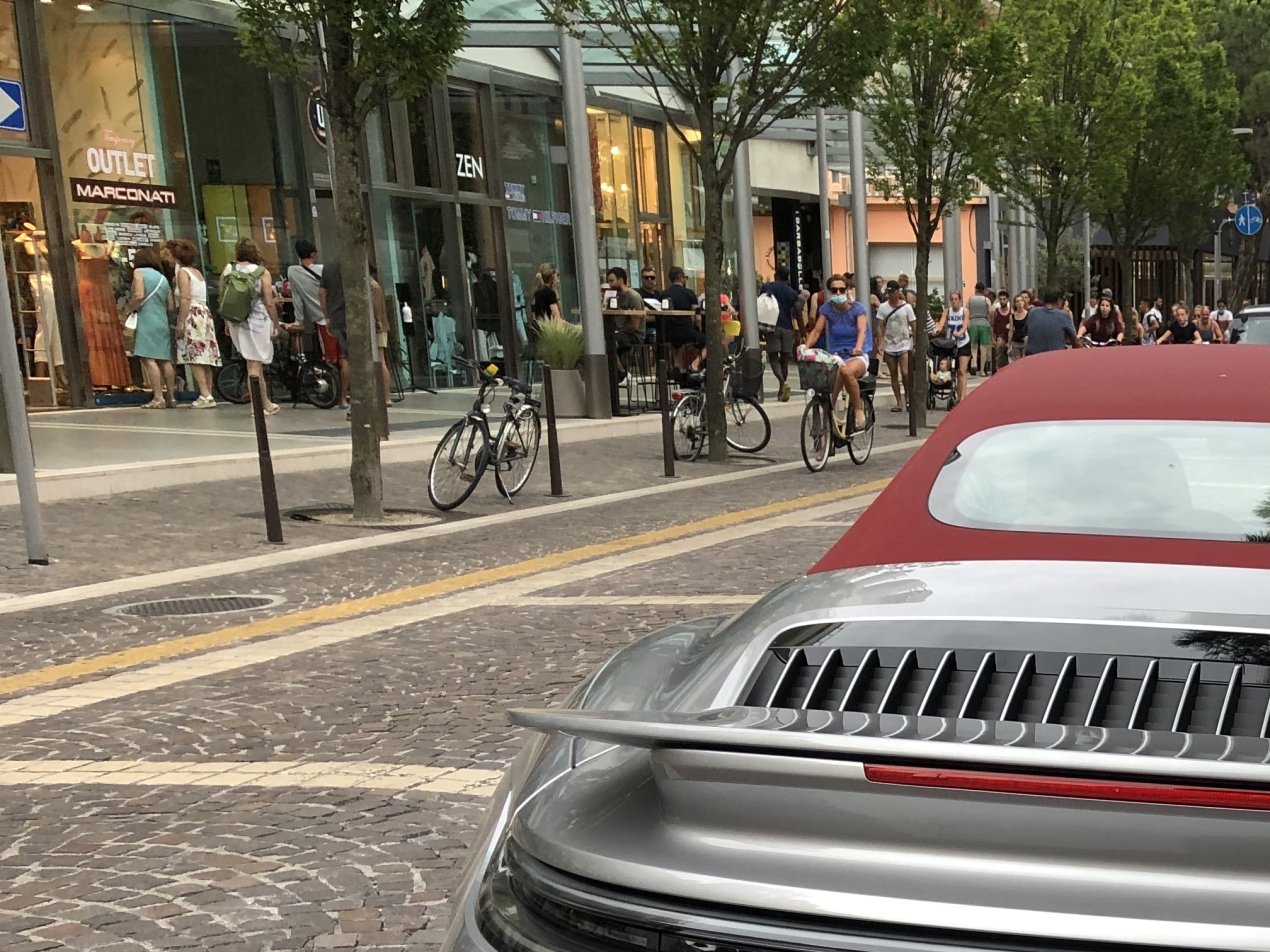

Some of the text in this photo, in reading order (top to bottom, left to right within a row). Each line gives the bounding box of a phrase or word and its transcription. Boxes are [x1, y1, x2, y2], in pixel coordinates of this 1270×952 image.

[86, 147, 155, 178] OUTLET
[455, 153, 484, 179] ZEN
[75, 183, 176, 204] MARCONATI
